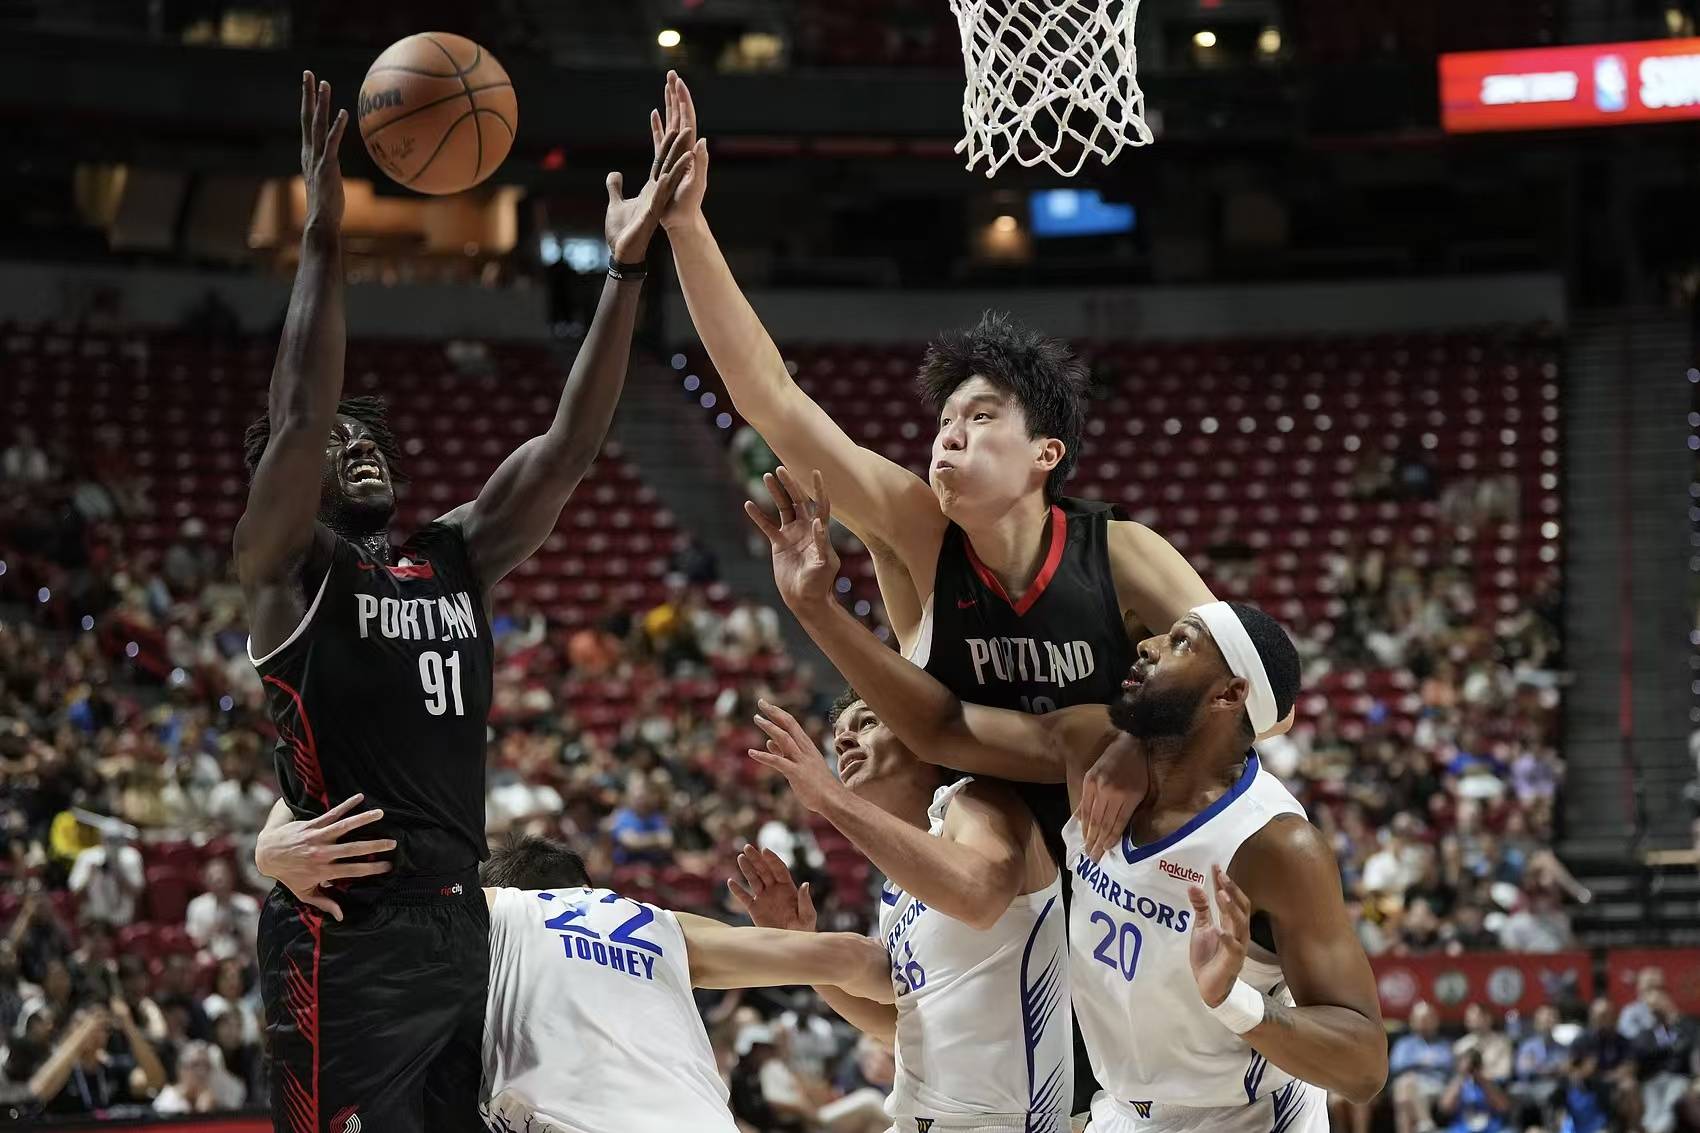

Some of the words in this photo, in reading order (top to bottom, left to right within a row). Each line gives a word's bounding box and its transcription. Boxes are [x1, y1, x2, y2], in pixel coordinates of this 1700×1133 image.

[418, 650, 465, 716] 91
[1076, 853, 1190, 933] WARRIORS
[1159, 860, 1205, 885] Rakuten
[537, 892, 663, 957] 22
[559, 934, 655, 980] TOOHEY
[1090, 910, 1143, 982] 20
